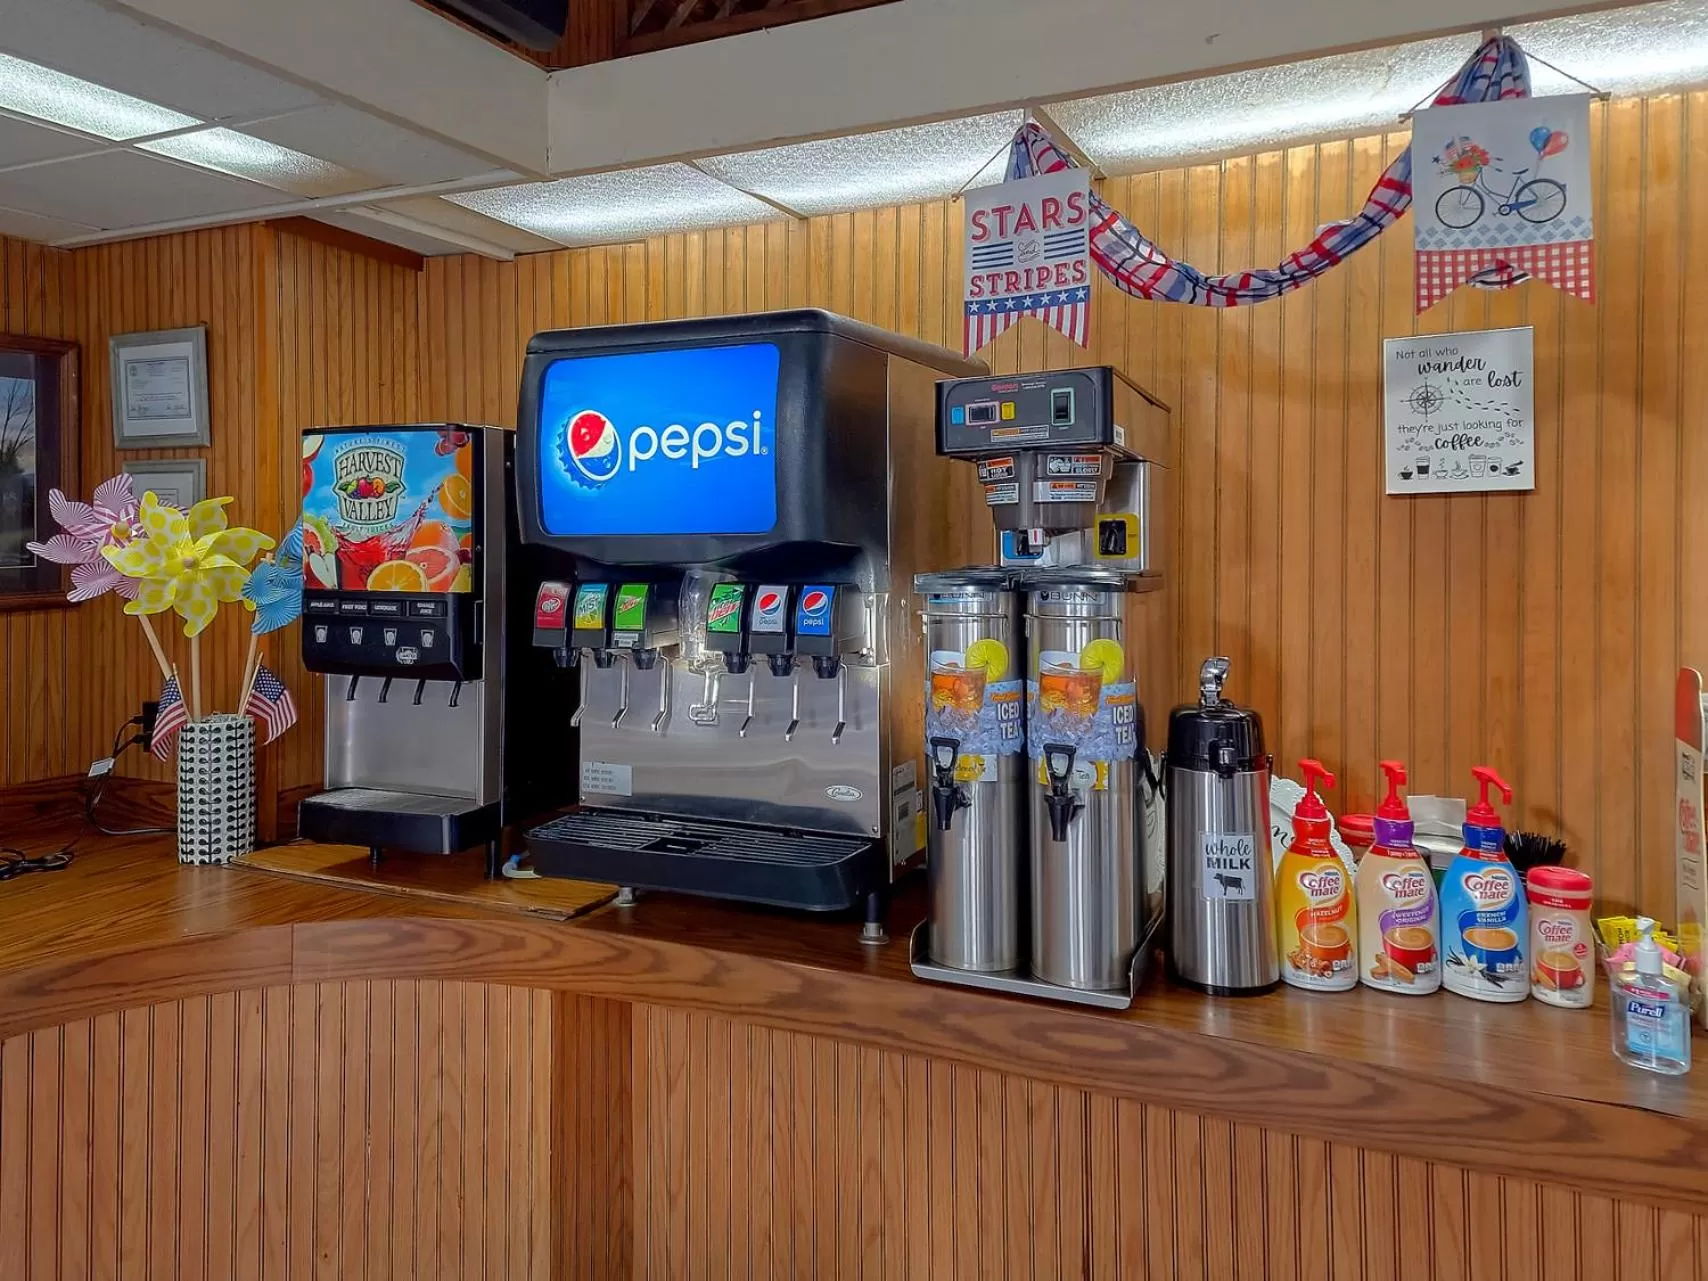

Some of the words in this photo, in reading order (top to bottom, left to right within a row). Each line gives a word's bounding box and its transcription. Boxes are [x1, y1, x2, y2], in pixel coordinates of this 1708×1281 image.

[971, 192, 1087, 243] STARS
[970, 260, 1086, 299] STRIPES
[1396, 350, 1415, 360] Not
[1419, 348, 1432, 359] all
[1436, 346, 1459, 356] who
[1418, 356, 1486, 375] wander
[1463, 377, 1482, 386] are
[1487, 370, 1523, 388] lost
[1398, 423, 1434, 437] they're
[1436, 422, 1459, 435] just
[1463, 419, 1503, 431] looking
[1507, 418, 1524, 428] for
[629, 410, 762, 472] pepsi
[1435, 433, 1484, 451] coffee
[338, 451, 400, 479] HARVEST
[343, 497, 393, 521] VALLEY
[1050, 591, 1098, 600] BUNN
[803, 617, 824, 627] pepsi
[997, 702, 1020, 721] ICED
[1113, 705, 1134, 725] ICED
[1000, 722, 1019, 740] TEA
[1116, 725, 1133, 745] TEA
[1205, 838, 1252, 856] whole
[1206, 858, 1252, 870] MILK
[1311, 886, 1340, 897] mate
[1394, 888, 1425, 898] mate
[1478, 889, 1508, 900] mate
[1545, 935, 1571, 943] mate
[1631, 1002, 1663, 1017] Purell
